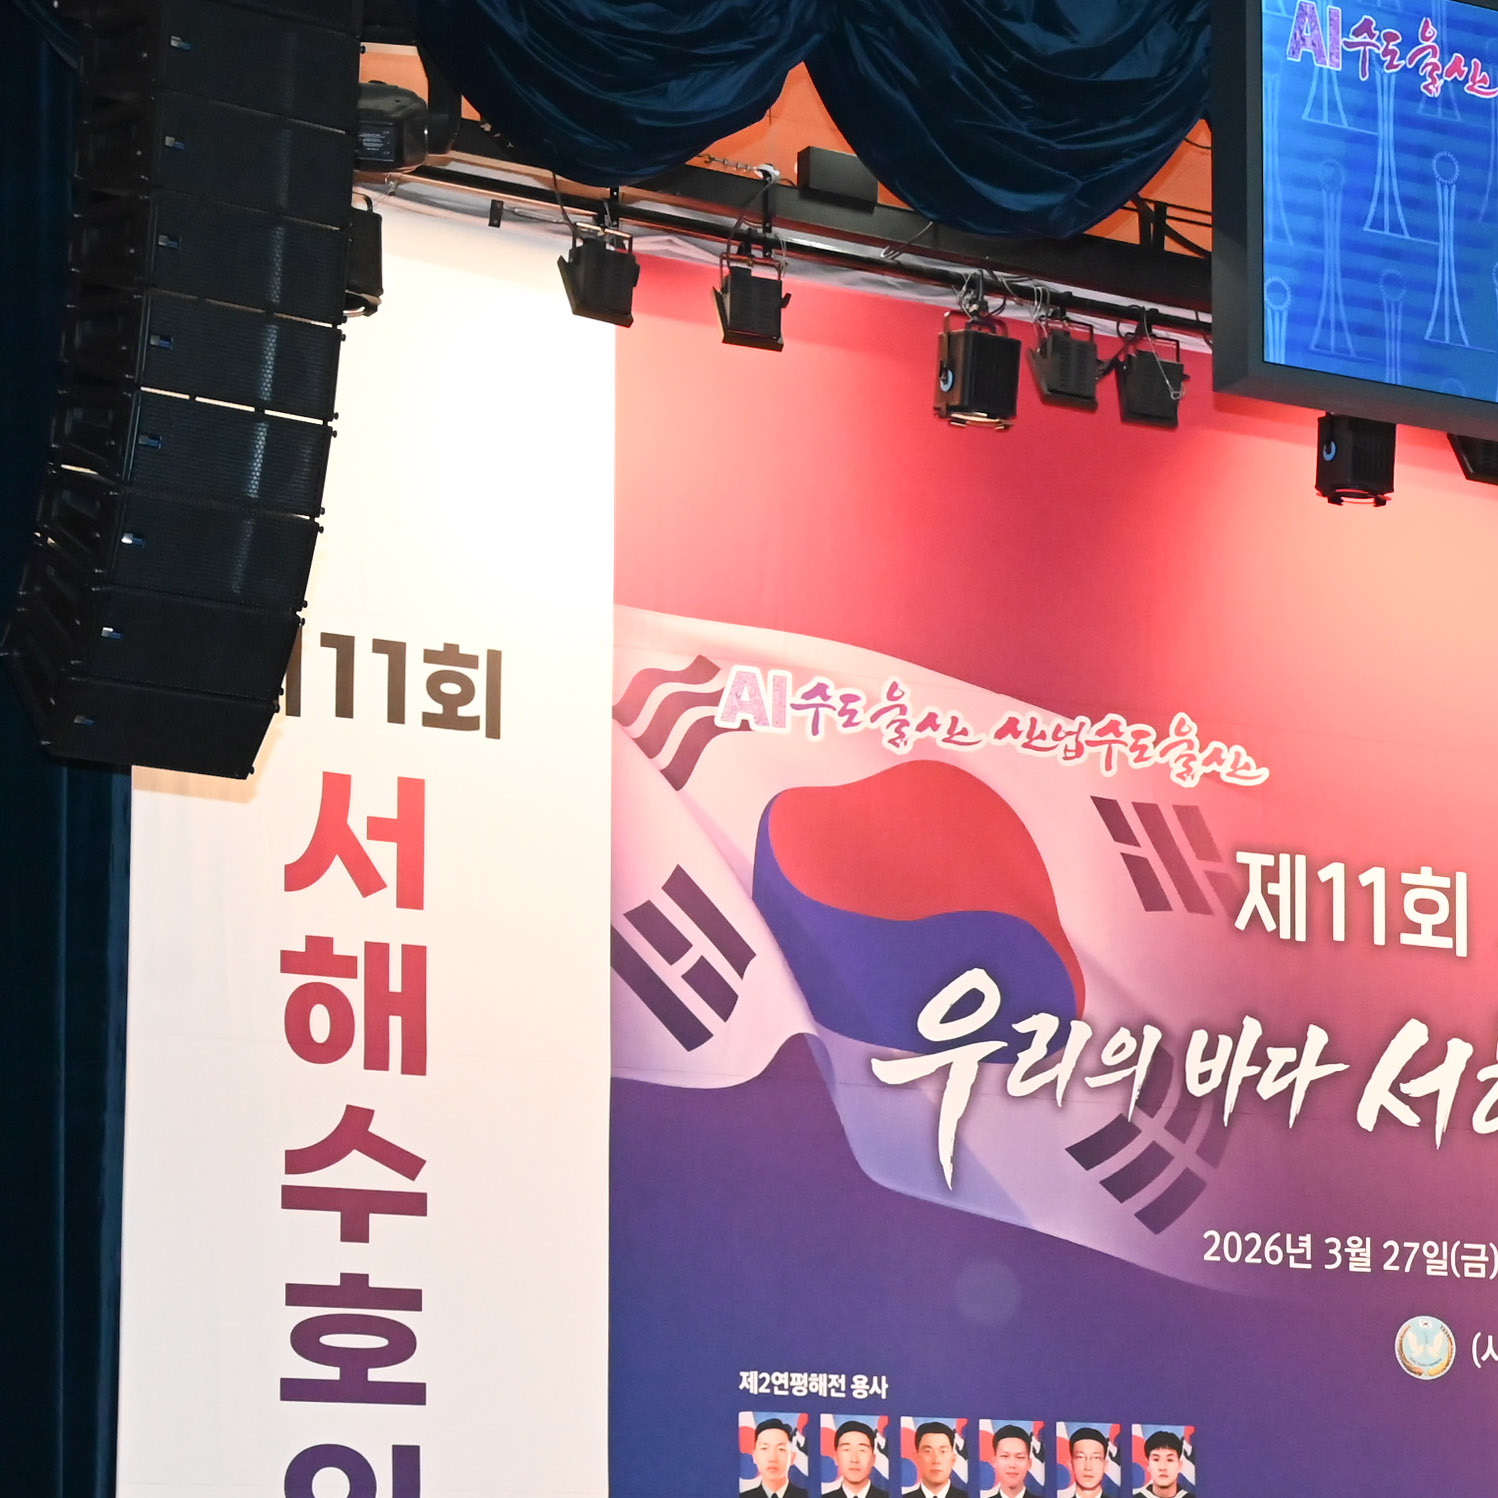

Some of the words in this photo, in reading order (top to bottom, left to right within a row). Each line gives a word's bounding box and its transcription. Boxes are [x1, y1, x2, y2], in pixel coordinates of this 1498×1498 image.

[283, 632, 502, 740] 11회
[994, 714, 1267, 785] 산업수도울산
[1234, 850, 1469, 958] 제11회
[871, 967, 1164, 1195] 우리의
[1186, 1012, 1350, 1129] 바다
[1202, 1229, 1312, 1271] 2026년
[1324, 1235, 1372, 1274] 3월
[739, 1370, 846, 1398] 제2연평해전
[850, 1374, 888, 1399] 용사
